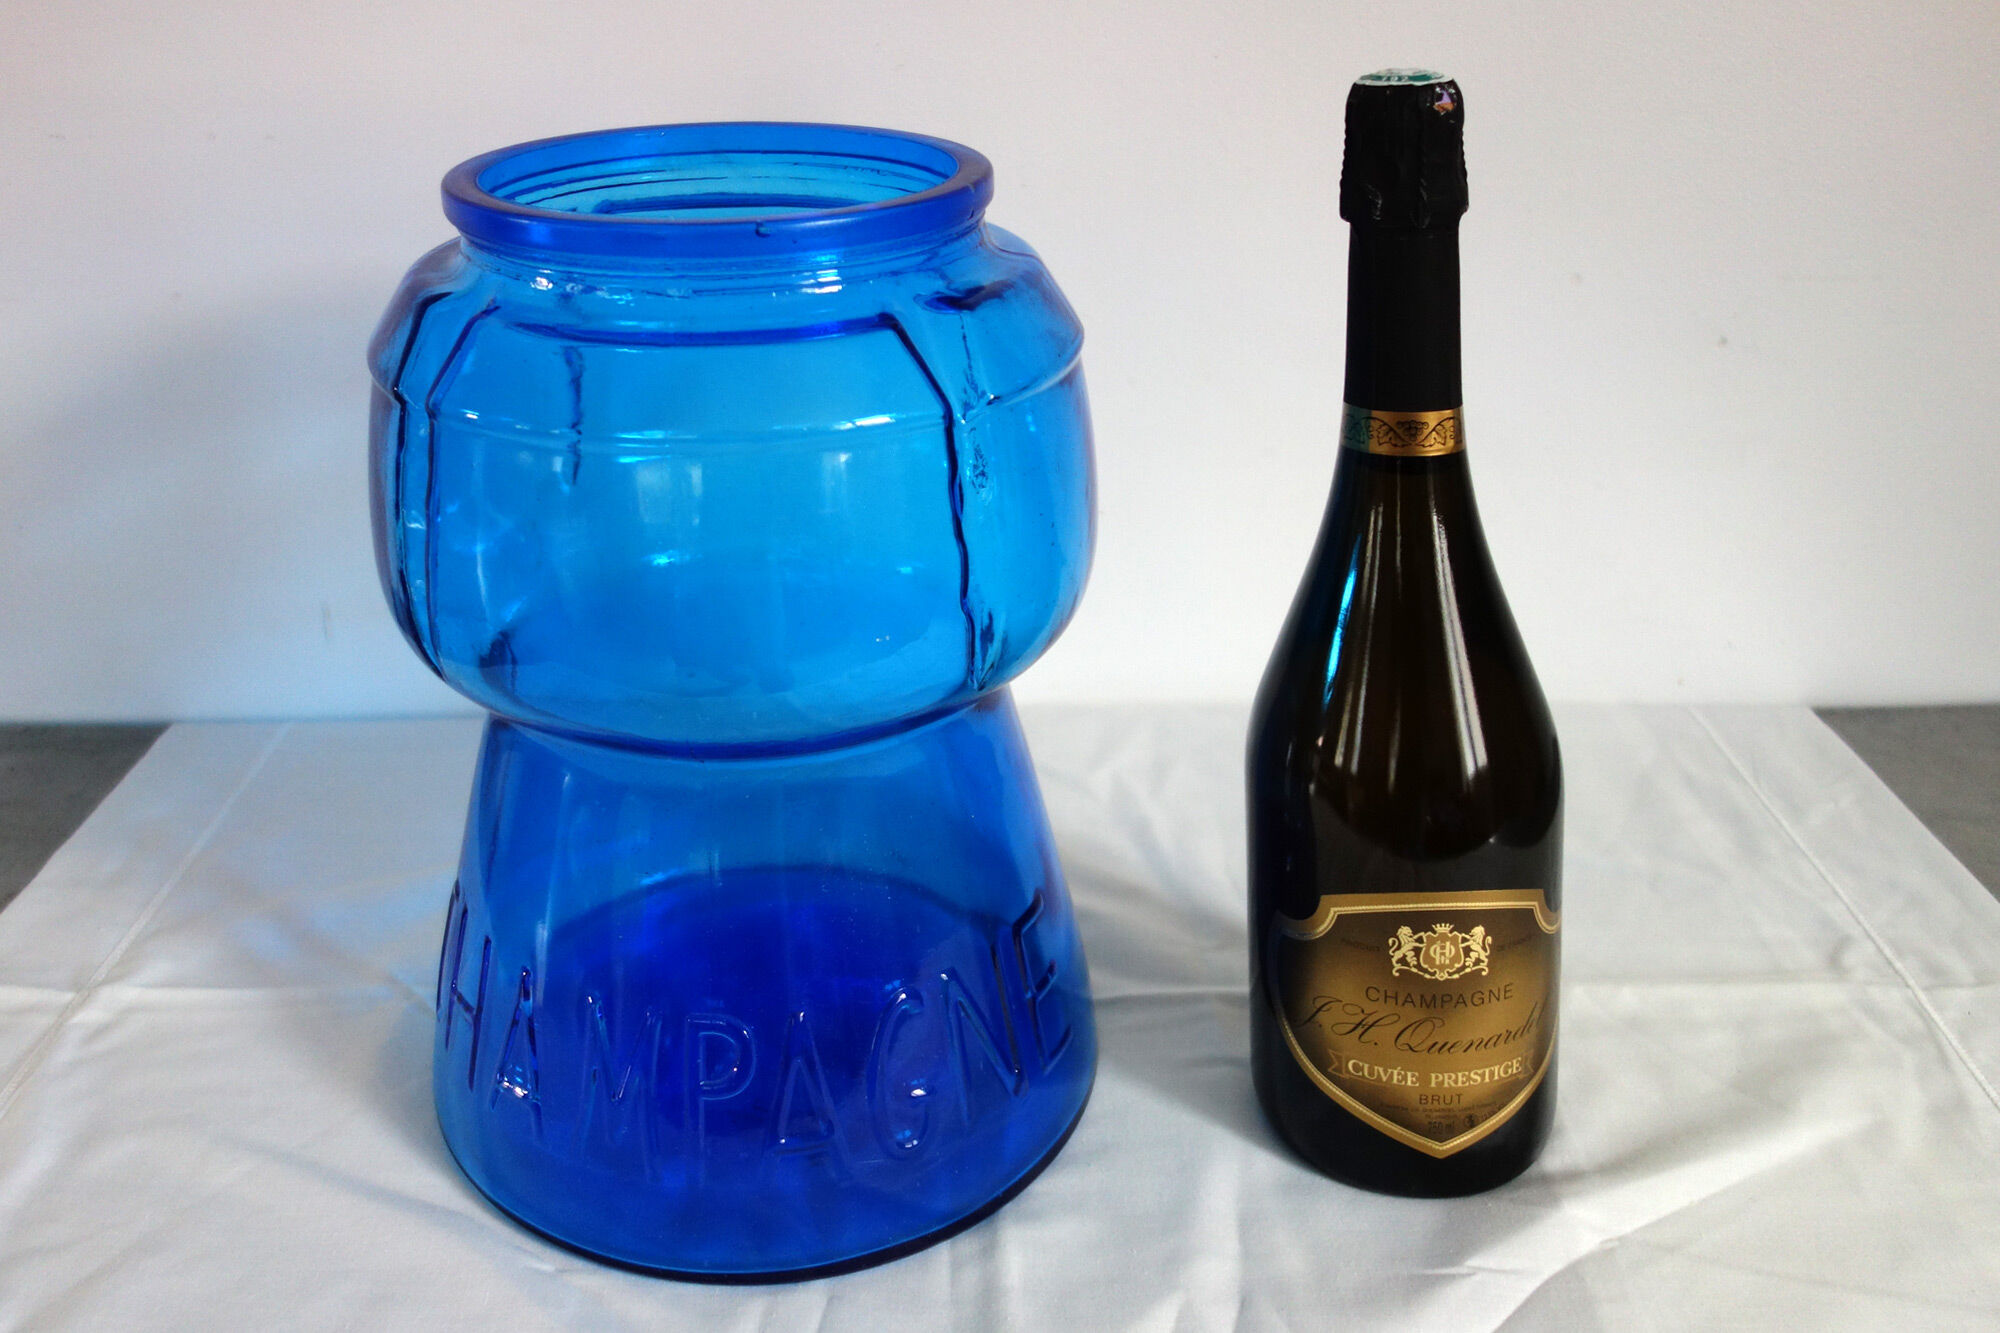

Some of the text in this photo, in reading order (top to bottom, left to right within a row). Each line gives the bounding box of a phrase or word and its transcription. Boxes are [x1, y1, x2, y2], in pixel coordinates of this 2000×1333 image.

[1364, 982, 1514, 1010] CHAMPAGNE
[435, 878, 1073, 1176] HAMPAGNE
[1330, 1003, 1401, 1046] H.
[1346, 1056, 1523, 1088] CUVÉE PRESTIGE
[1418, 1093, 1463, 1107] BRUT
